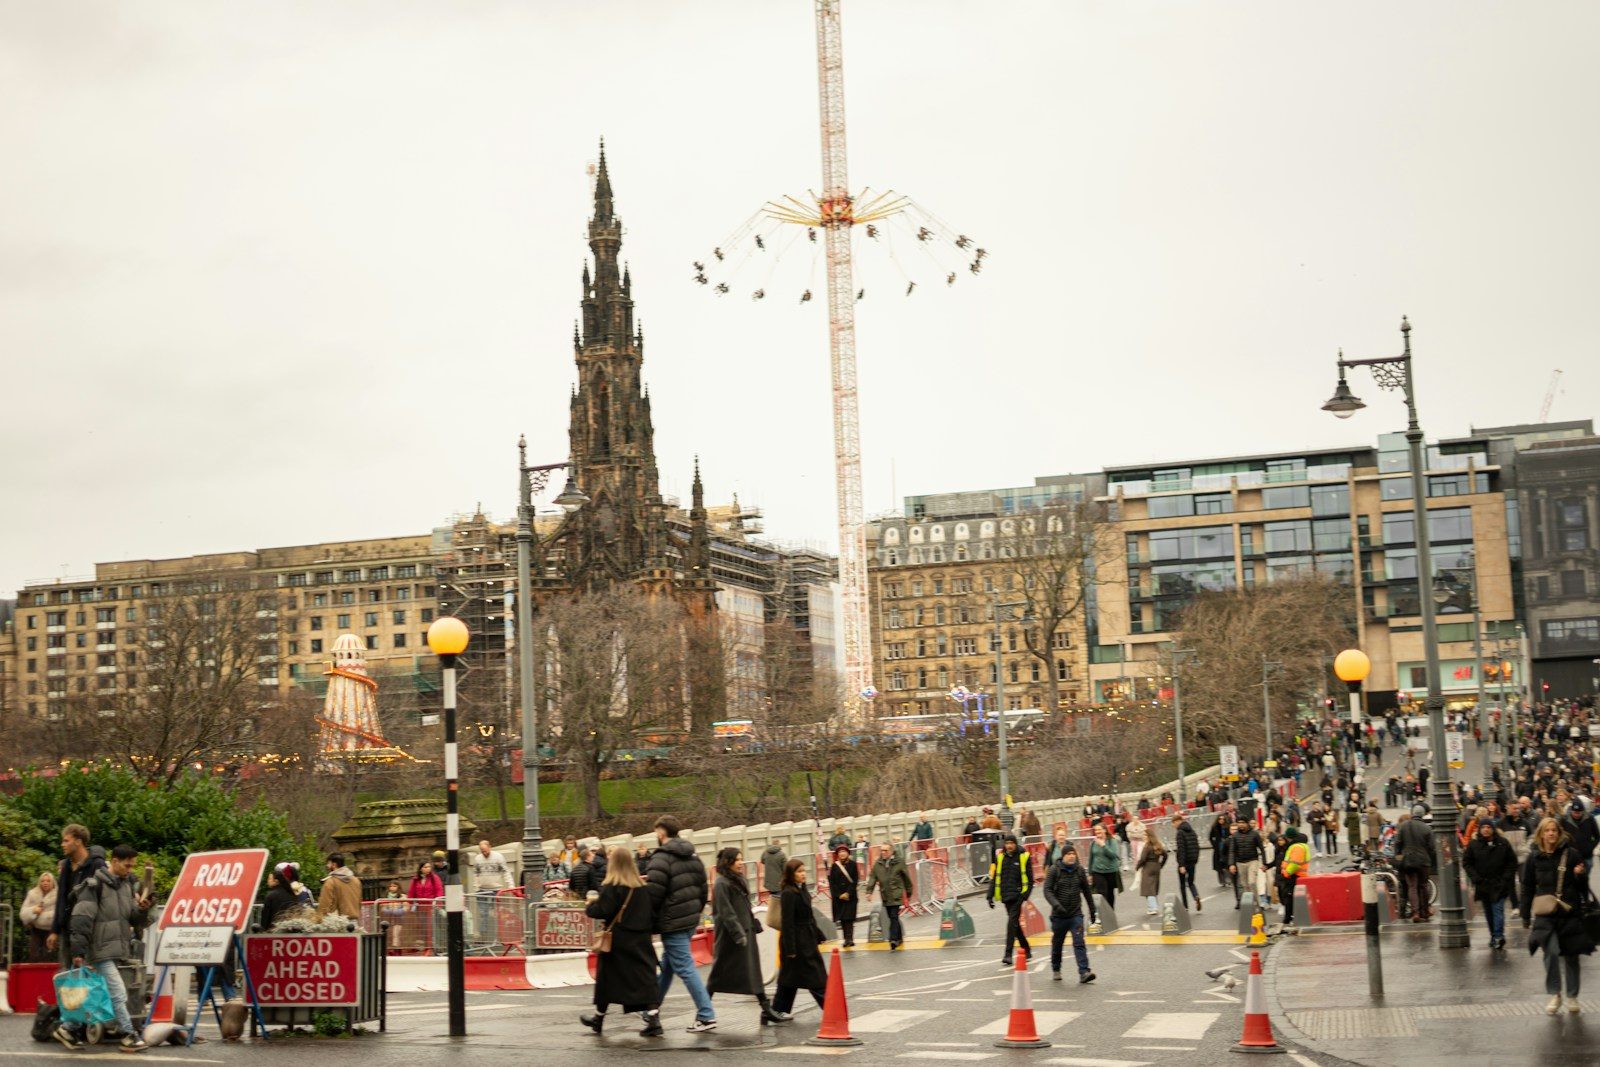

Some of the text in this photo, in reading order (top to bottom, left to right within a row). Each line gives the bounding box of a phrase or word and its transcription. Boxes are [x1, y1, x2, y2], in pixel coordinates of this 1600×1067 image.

[193, 862, 244, 887] ROAD
[171, 898, 243, 924] CLOSED
[549, 911, 581, 923] ROAD
[545, 922, 585, 934] AHEAD
[272, 939, 333, 957] ROAD
[542, 934, 588, 945] CLOSED
[264, 961, 340, 979] AHEAD
[257, 982, 346, 1001] CLOSED
